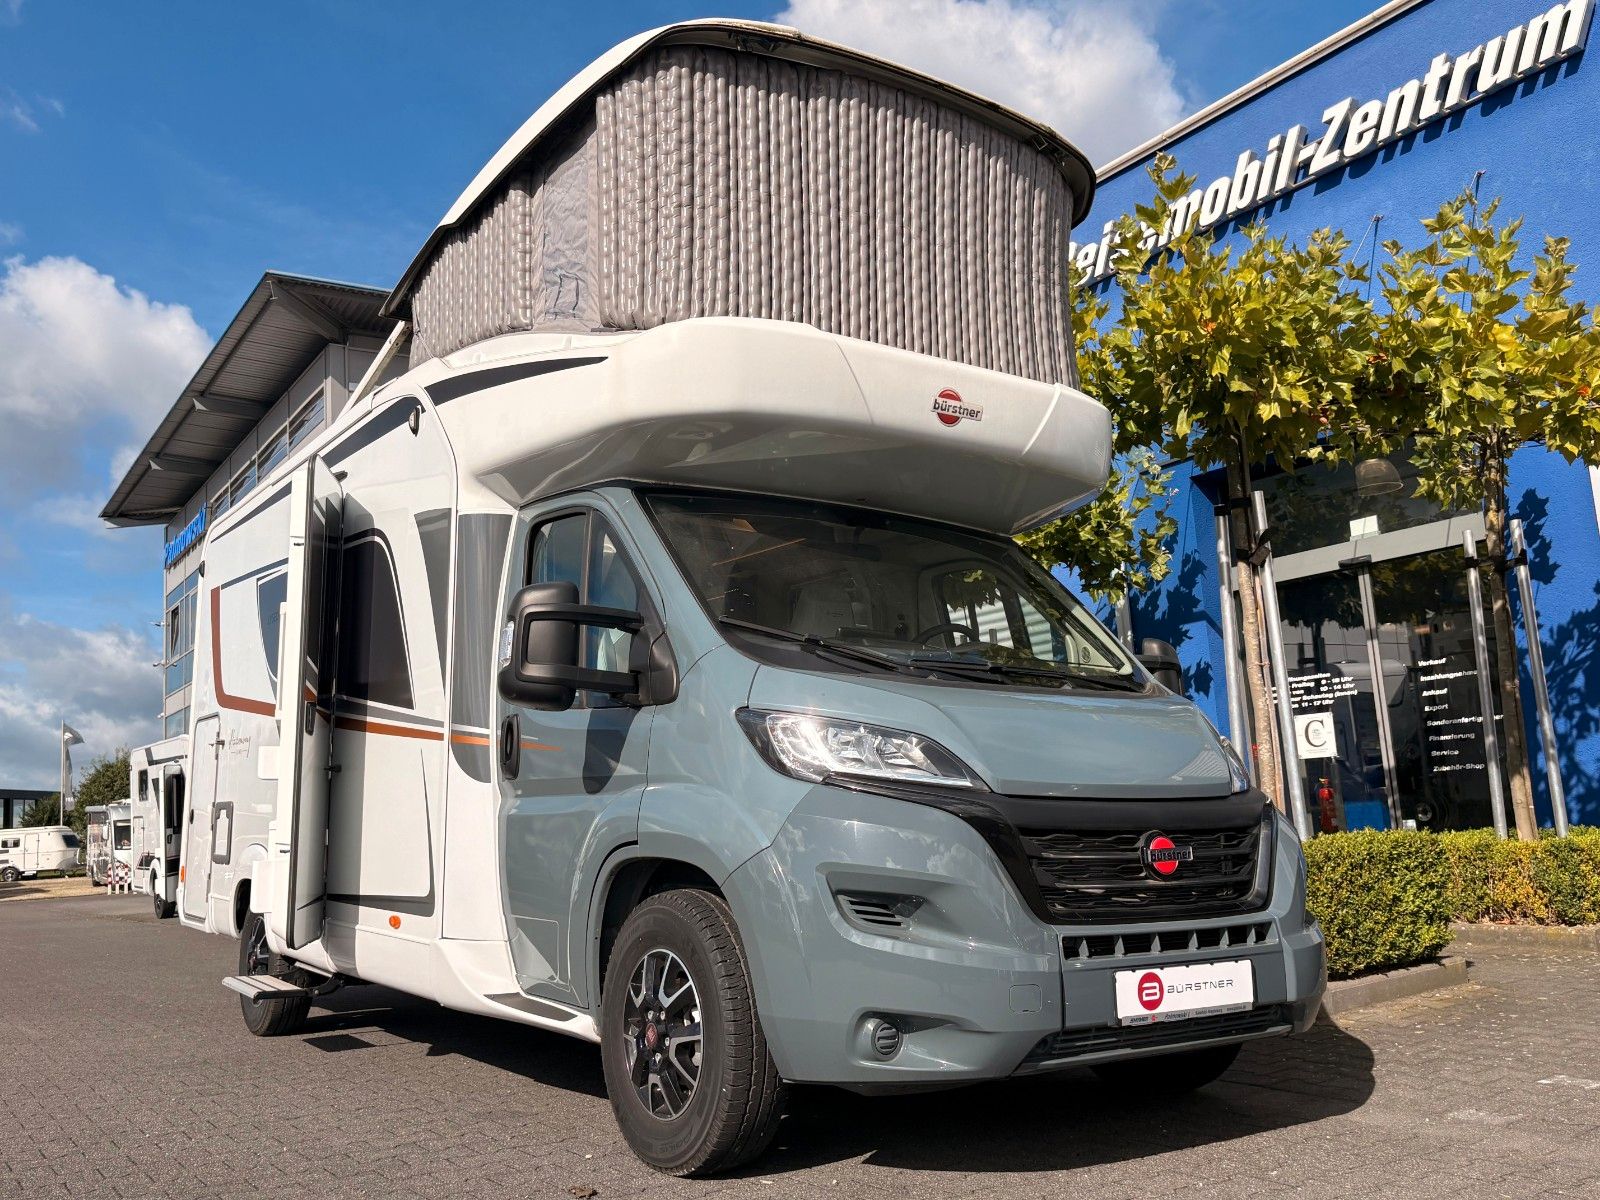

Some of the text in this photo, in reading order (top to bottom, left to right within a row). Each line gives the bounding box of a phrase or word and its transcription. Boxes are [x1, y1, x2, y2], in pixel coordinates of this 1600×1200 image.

[1069, 0, 1597, 290] eimobil-Zentrum
[933, 398, 981, 418] bürstner
[1418, 657, 1446, 667] Verkauf
[1422, 687, 1448, 697] Ankauf
[1424, 703, 1449, 712] Export
[1304, 719, 1327, 748] C
[1429, 732, 1475, 742] Finanzierung
[1431, 749, 1459, 757] Service
[1433, 763, 1485, 772] Zubehör-Shop
[1167, 979, 1234, 994] BÜRSTNER
